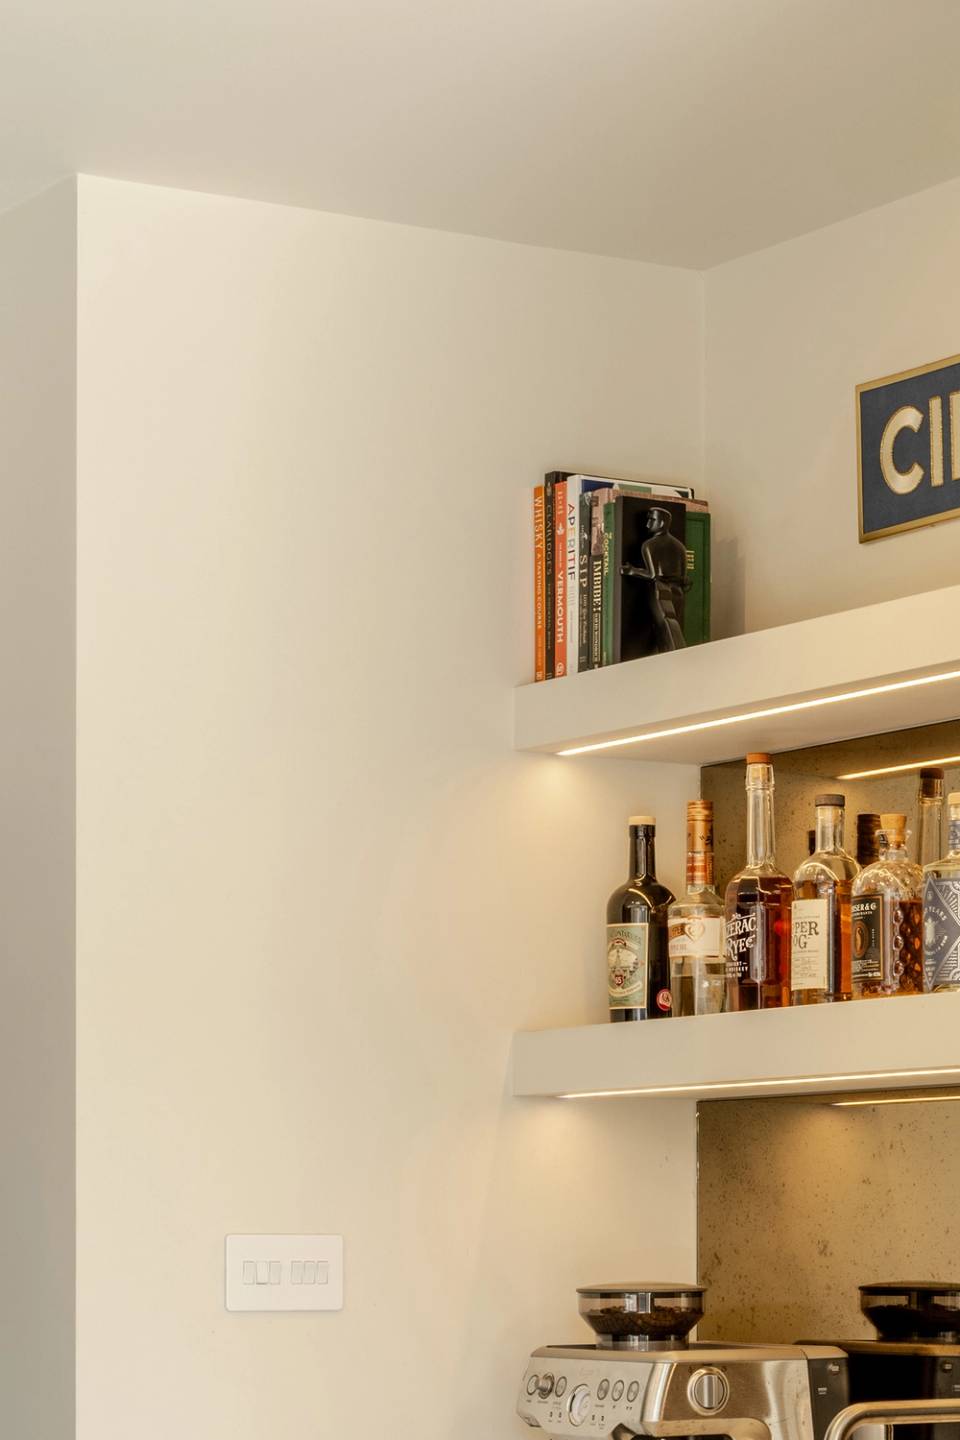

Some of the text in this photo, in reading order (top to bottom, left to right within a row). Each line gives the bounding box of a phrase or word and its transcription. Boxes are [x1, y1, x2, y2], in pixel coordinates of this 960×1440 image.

[535, 495, 545, 549] WHISKY
[567, 503, 576, 581] APERITIF
[556, 570, 567, 643] VERMOUTH
